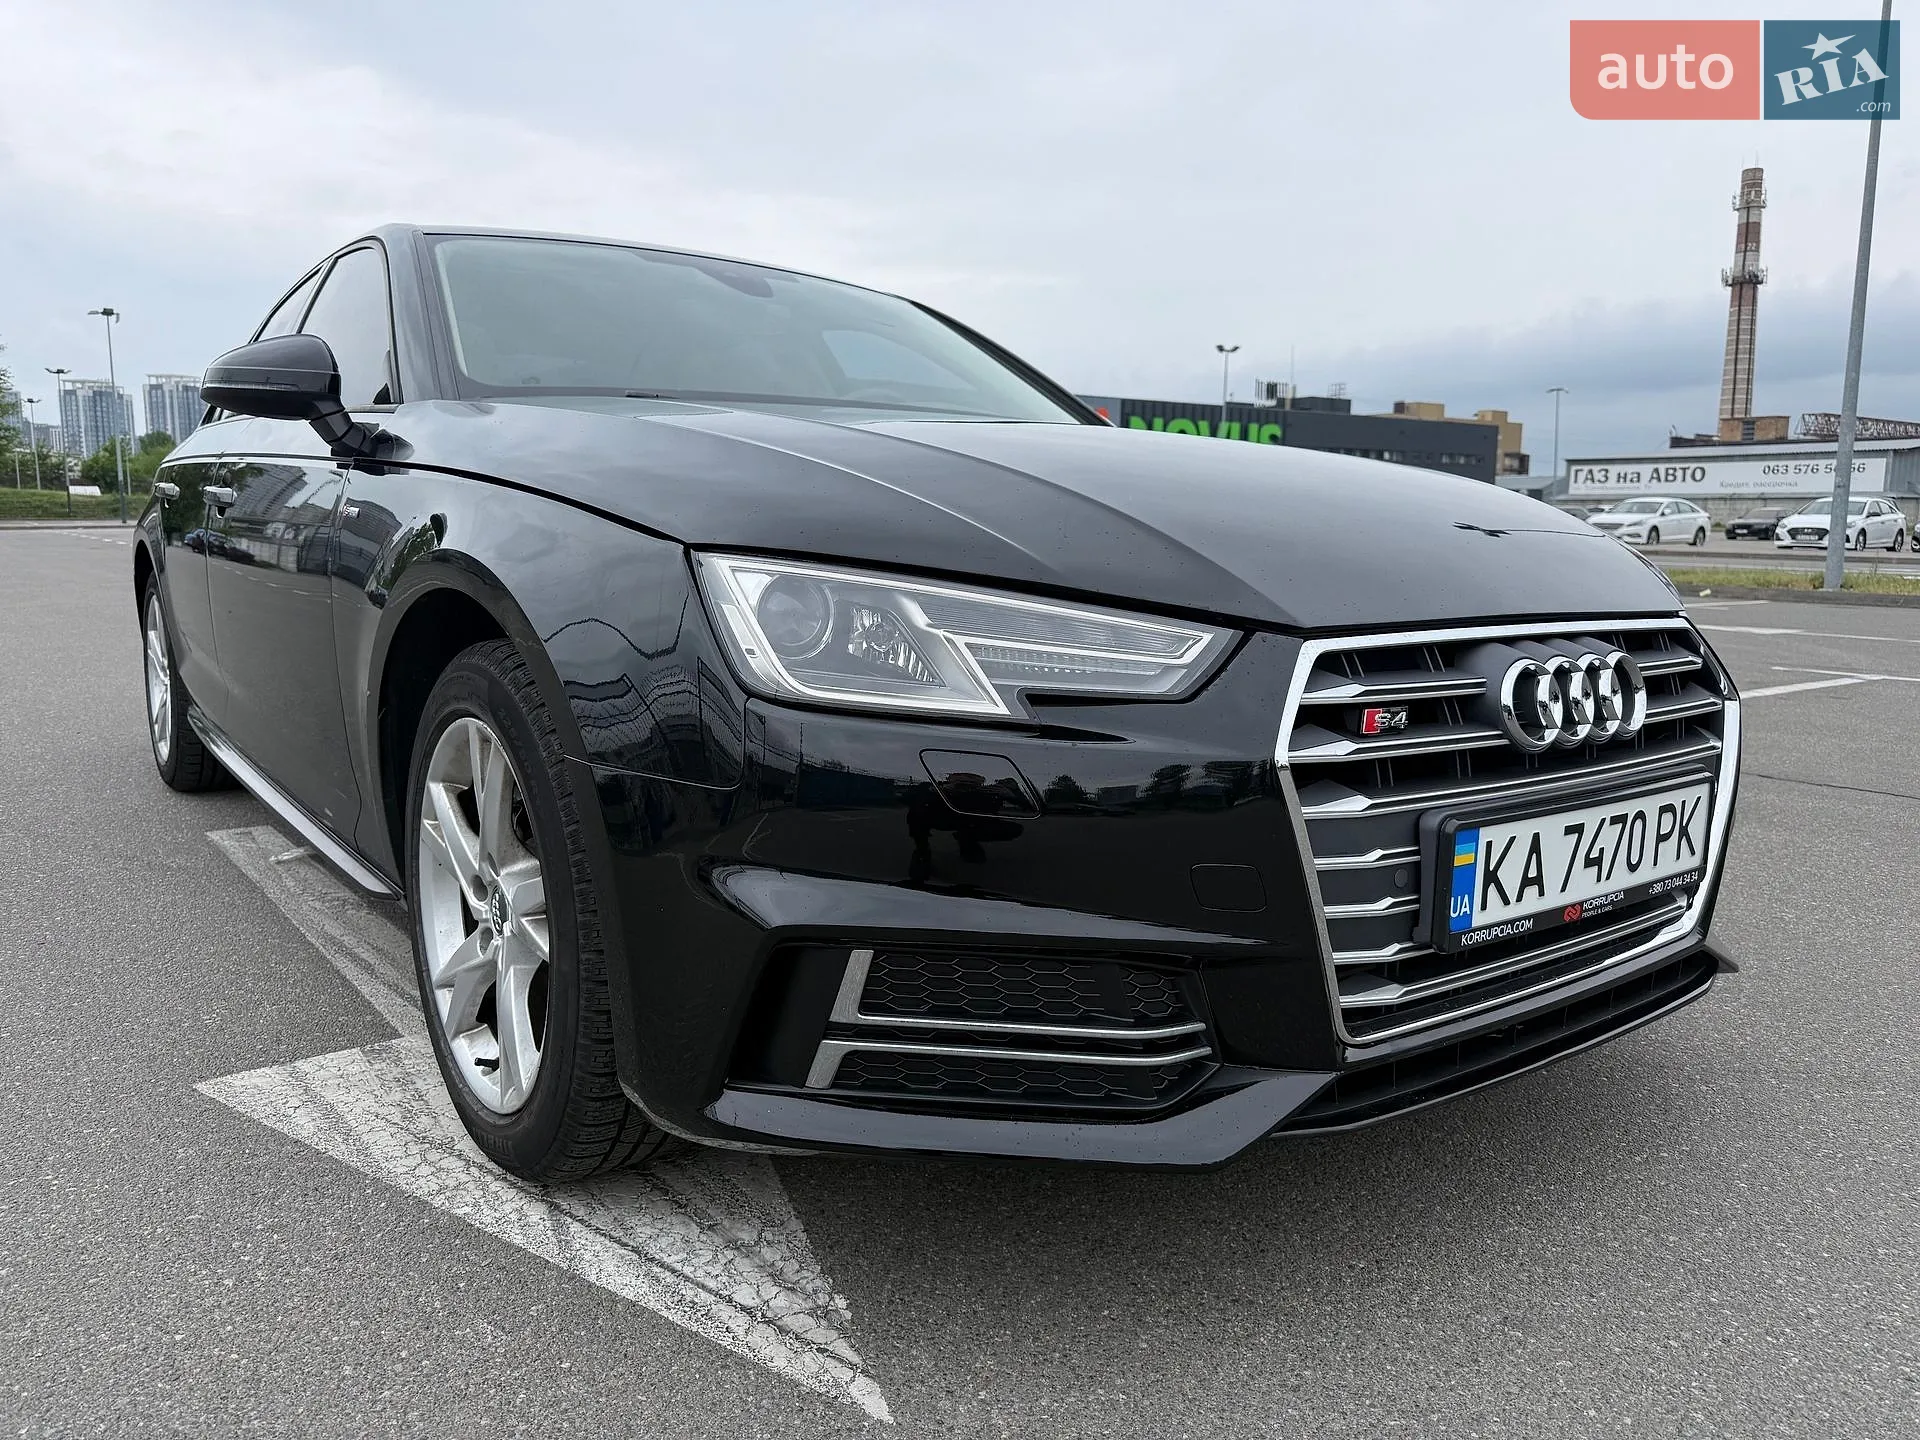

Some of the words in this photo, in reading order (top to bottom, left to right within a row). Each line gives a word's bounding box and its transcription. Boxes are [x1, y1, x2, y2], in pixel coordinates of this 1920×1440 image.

[1573, 468, 1609, 484] ГАЗ
[1616, 471, 1641, 484] на
[1649, 466, 1706, 484] АВТО
[1762, 463, 1789, 475] 063
[1793, 463, 1819, 475] 576
[1374, 711, 1408, 728] S4
[1480, 831, 1545, 912] KA
[1559, 809, 1647, 893] 7470
[1652, 795, 1702, 867] PK
[1648, 881, 1664, 895] +380
[1663, 879, 1671, 890] 73
[1672, 876, 1683, 888] 044
[1683, 873, 1691, 884] 34
[1690, 871, 1698, 882] 34
[1449, 894, 1471, 918] UA
[1582, 891, 1625, 910] KORRUPCIA
[1581, 908, 1598, 918] PEOPLE
[1460, 918, 1534, 946] KORRUPCIA.COM
